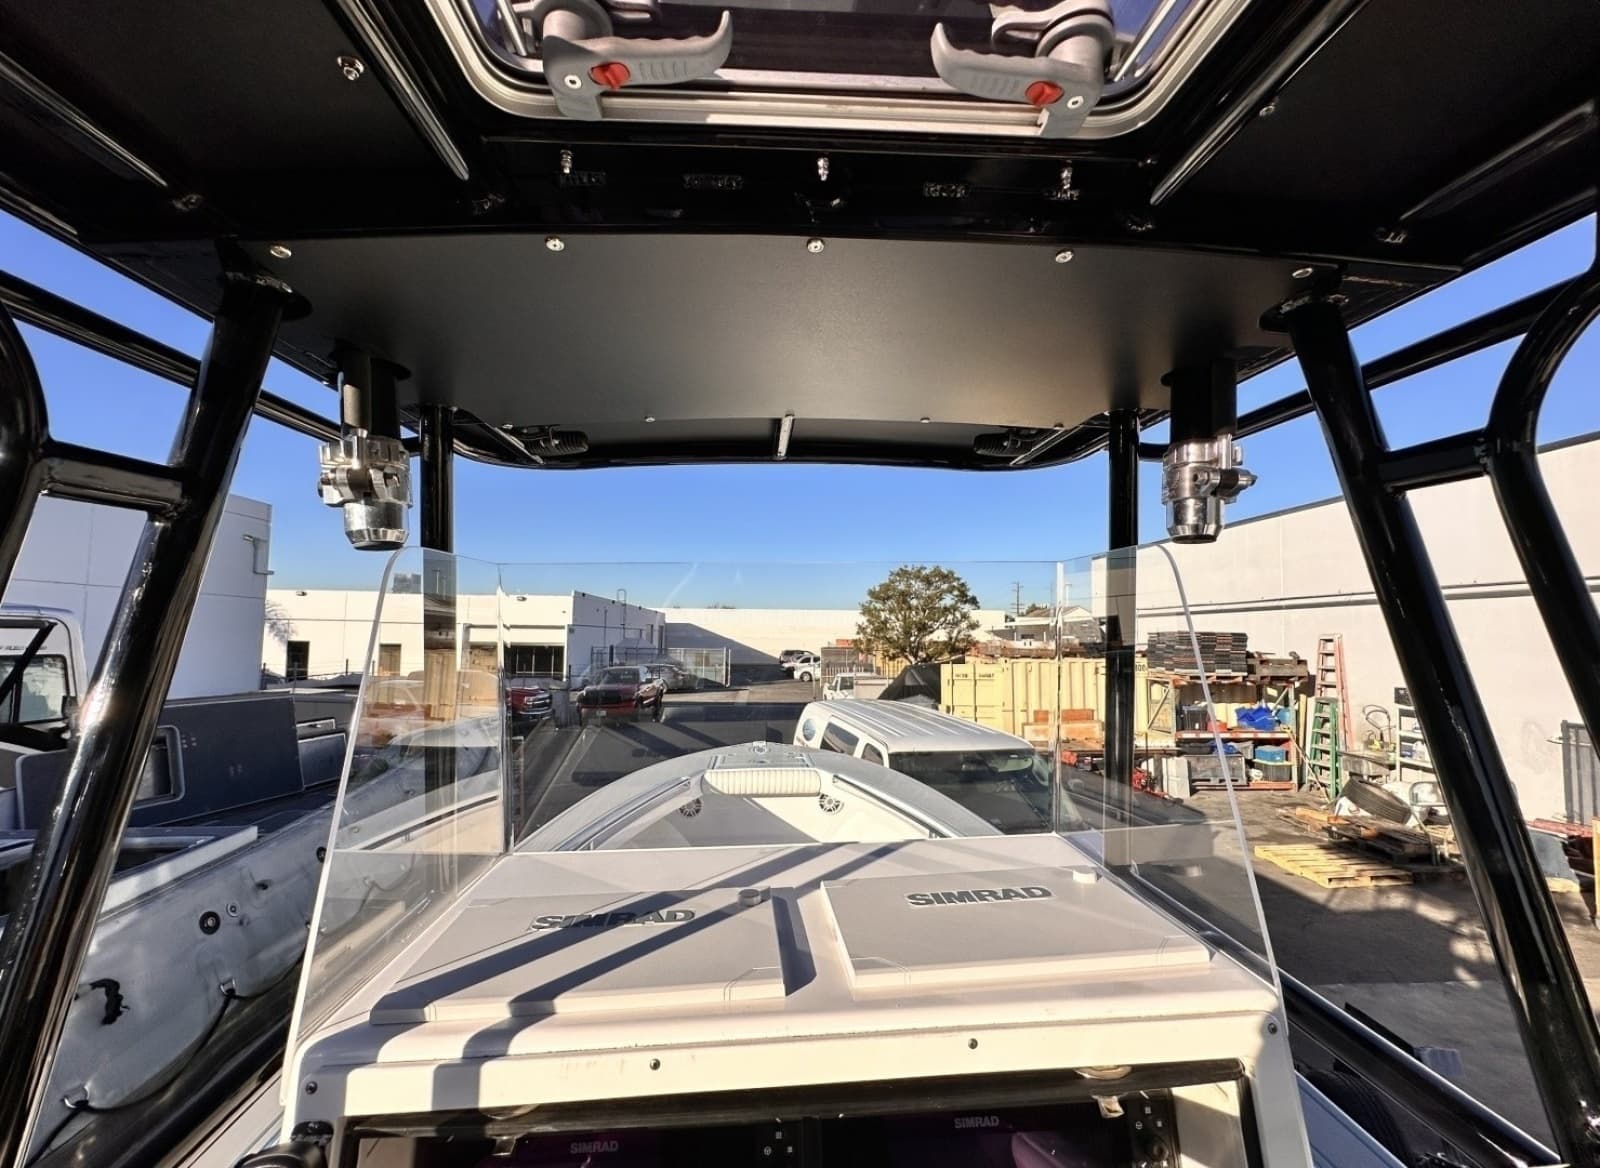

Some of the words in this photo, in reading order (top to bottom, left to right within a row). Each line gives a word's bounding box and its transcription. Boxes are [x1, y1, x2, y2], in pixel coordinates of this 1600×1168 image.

[907, 886, 1051, 906] SIMRAD
[531, 909, 696, 930] SIMRAD
[953, 1115, 999, 1129] SIMRAD
[570, 1140, 619, 1154] SIMRAD
